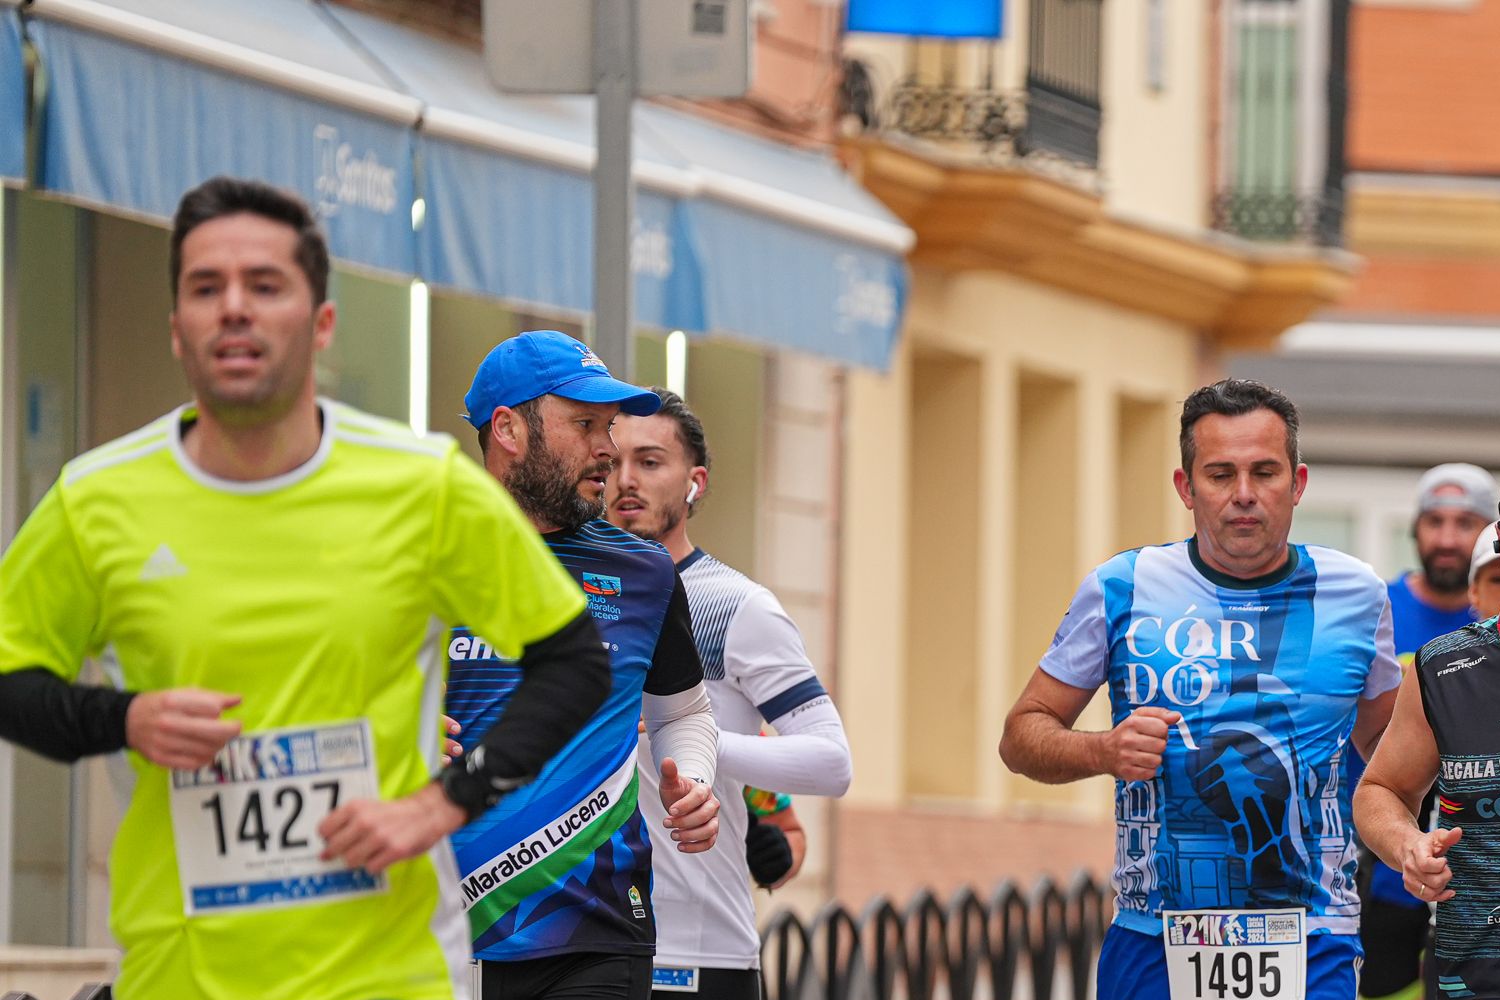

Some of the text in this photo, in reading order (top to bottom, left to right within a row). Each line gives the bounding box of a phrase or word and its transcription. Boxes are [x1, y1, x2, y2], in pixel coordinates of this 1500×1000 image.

[591, 610, 619, 621] ucena
[1442, 760, 1495, 779] REGALA
[461, 790, 610, 902] Maratón Lucena
[1183, 915, 1223, 945] 21K
[1188, 951, 1281, 999] 1495
